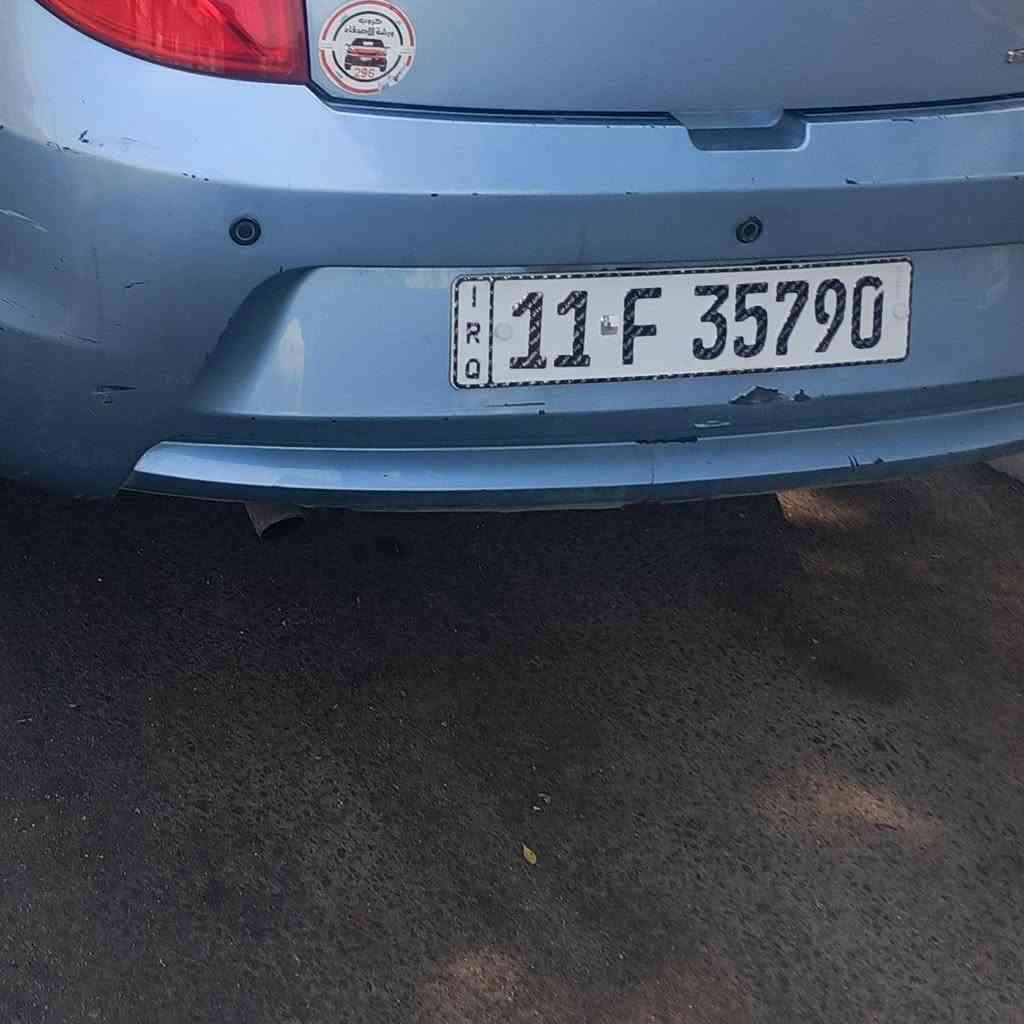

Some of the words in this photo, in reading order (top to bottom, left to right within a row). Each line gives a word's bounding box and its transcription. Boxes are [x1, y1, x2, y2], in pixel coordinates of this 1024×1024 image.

[508, 289, 592, 370] 11
[621, 286, 663, 365] F
[691, 275, 884, 361] 35790
